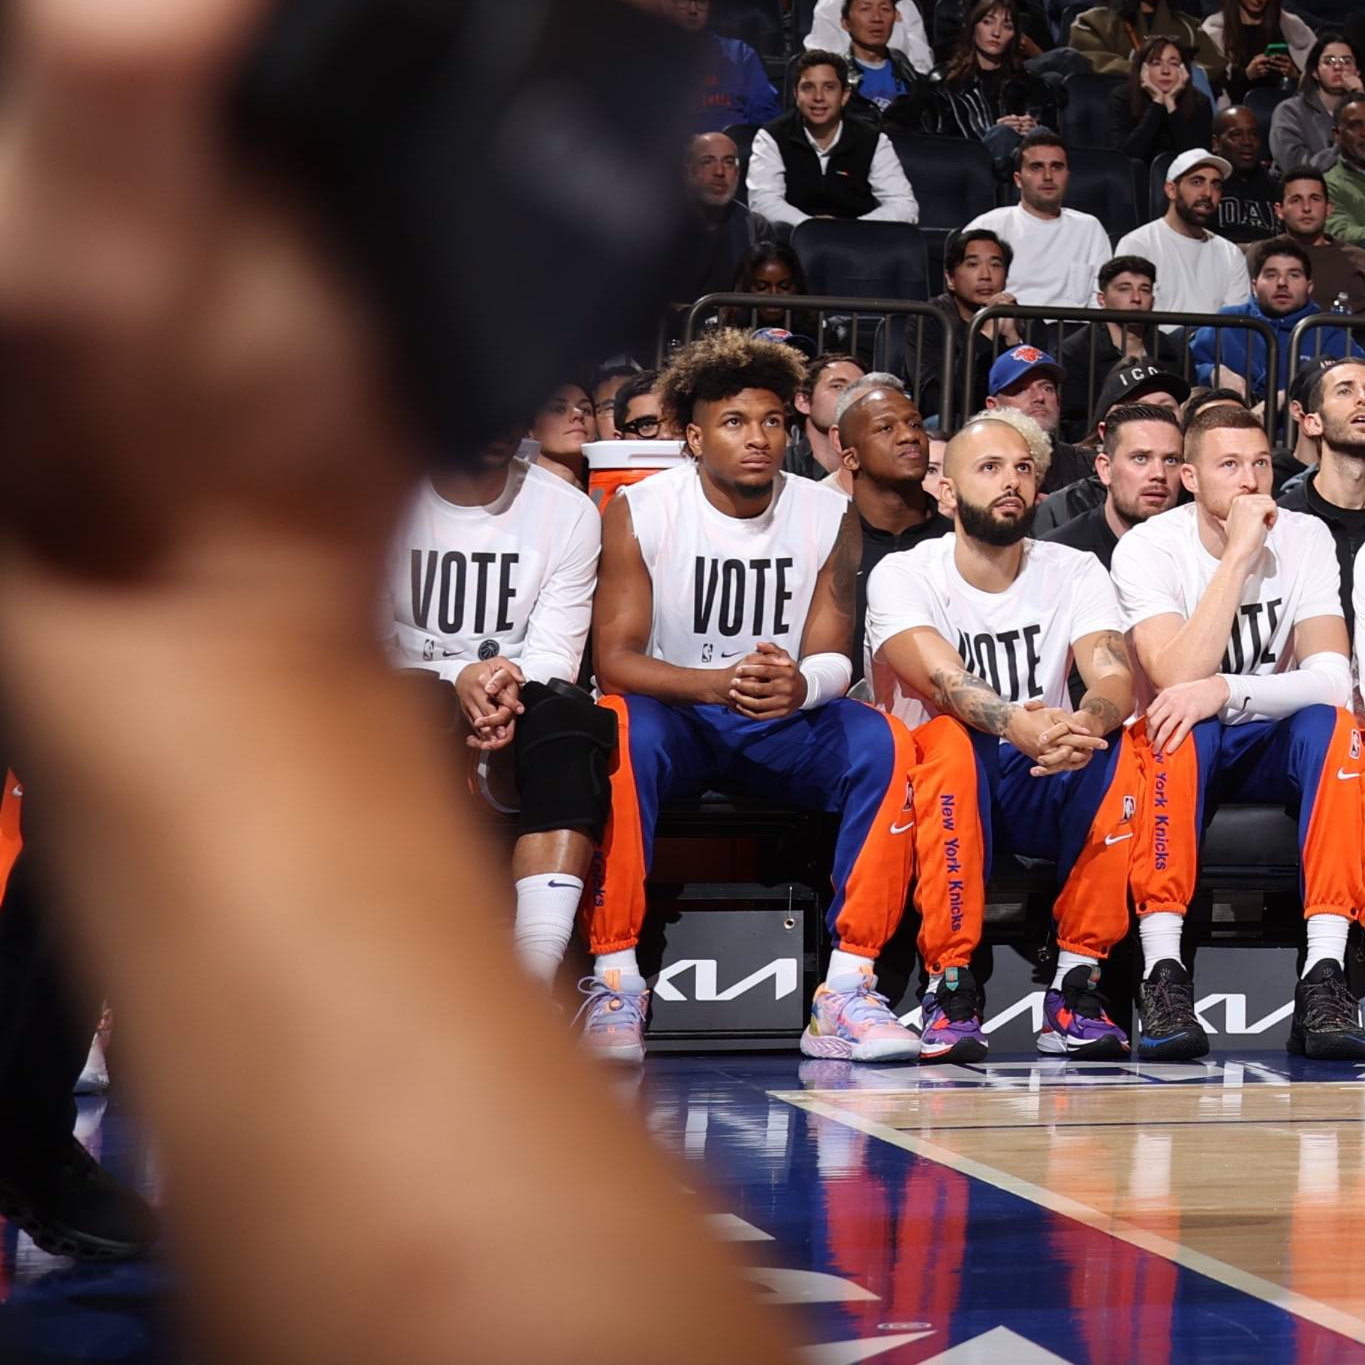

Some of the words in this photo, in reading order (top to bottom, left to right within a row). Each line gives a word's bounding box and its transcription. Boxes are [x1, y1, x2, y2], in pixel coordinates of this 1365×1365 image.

[411, 548, 519, 634] VOTE
[693, 555, 793, 636] VOTE
[940, 794, 955, 831] New
[1154, 770, 1167, 809] York
[943, 837, 960, 874] York
[1154, 815, 1169, 871] Knicks
[947, 880, 965, 932] Knicks
